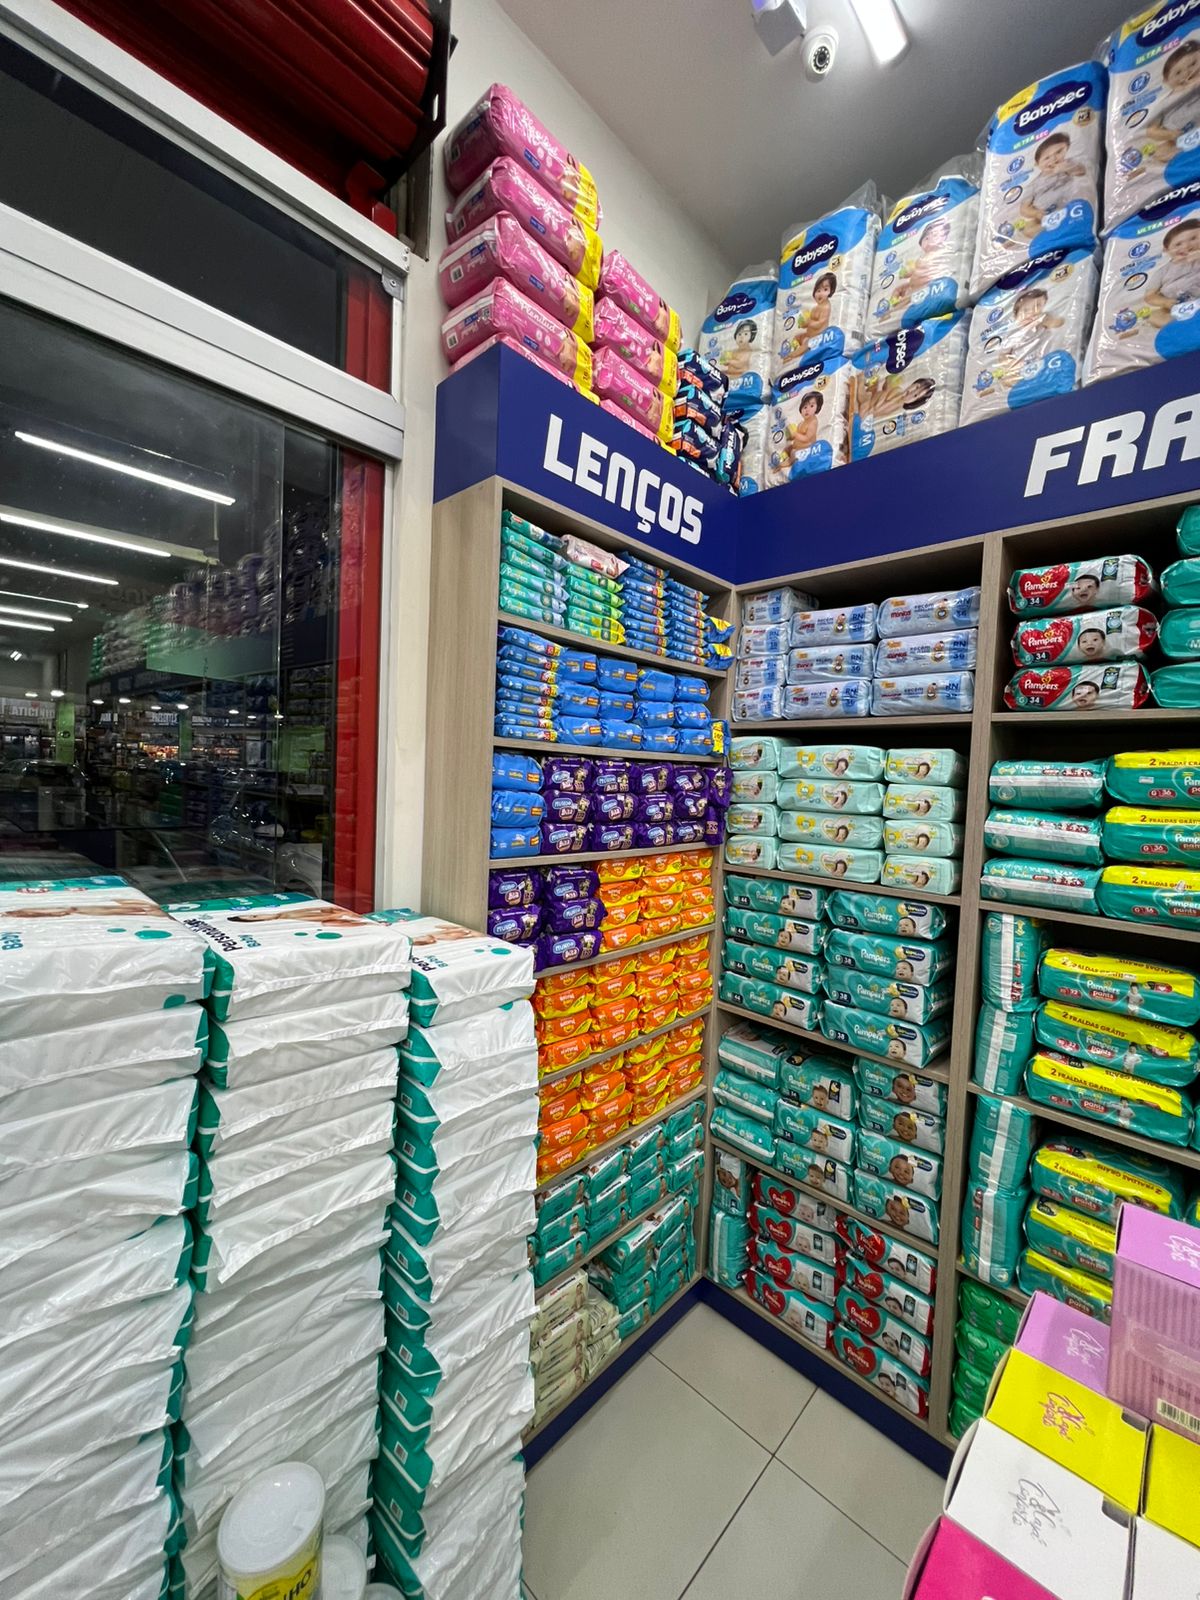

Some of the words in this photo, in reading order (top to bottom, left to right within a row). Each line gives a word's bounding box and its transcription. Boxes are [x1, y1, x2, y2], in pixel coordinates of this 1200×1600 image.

[1135, 48, 1162, 65] ULTRA
[1163, 38, 1181, 51] SEC
[1019, 87, 1086, 127] Babysec
[1013, 136, 1035, 150] ULTRA
[1035, 130, 1049, 141] SEC
[1183, 131, 1199, 145] 64
[1070, 205, 1083, 217] G
[1136, 221, 1163, 235] ULTRA
[1164, 216, 1181, 227] SEC
[794, 240, 836, 268] Babysec
[931, 284, 944, 296] M
[1178, 303, 1194, 314] 64
[825, 331, 835, 342] M
[896, 329, 909, 368] bysec
[1048, 356, 1061, 368] G
[744, 376, 753, 386] M
[781, 363, 822, 387] Babysec
[811, 445, 822, 455] M
[543, 413, 704, 545] LENÇOS
[1024, 580, 1058, 591] Pampers
[1028, 635, 1063, 646] Pampers
[1024, 681, 1058, 691] Pampers
[1150, 758, 1156, 766] 2
[1132, 876, 1138, 884] 2
[756, 891, 777, 903] Pampers
[864, 908, 893, 922] Pampers
[753, 923, 775, 935] Pampers
[861, 949, 891, 965] Pampers
[752, 958, 774, 971] Pampers
[857, 985, 885, 1001] Pampers
[1087, 980, 1120, 994] Pampers
[750, 992, 771, 1005] Pampers
[1092, 991, 1114, 999] pants
[1068, 1016, 1098, 1029] FRALDAS
[854, 1024, 884, 1041] Pampers
[1086, 1037, 1119, 1051] Pampers
[1091, 1046, 1112, 1056] pants
[788, 1075, 810, 1091] Pampers
[865, 1070, 888, 1084] Pampers
[1057, 1073, 1088, 1086] FRALDAS
[866, 1105, 889, 1120] Pampers
[1083, 1101, 1104, 1112] pants
[786, 1117, 809, 1133] Pampers
[783, 1153, 805, 1169] Pampers
[863, 1146, 885, 1162] Pampers
[858, 1187, 881, 1205] Pampers
[1068, 1185, 1103, 1204] Pampers
[1075, 1196, 1097, 1209] pants
[1068, 1299, 1092, 1314] pants
[850, 1307, 873, 1329] Pampers
[847, 1346, 870, 1368] Pampers
